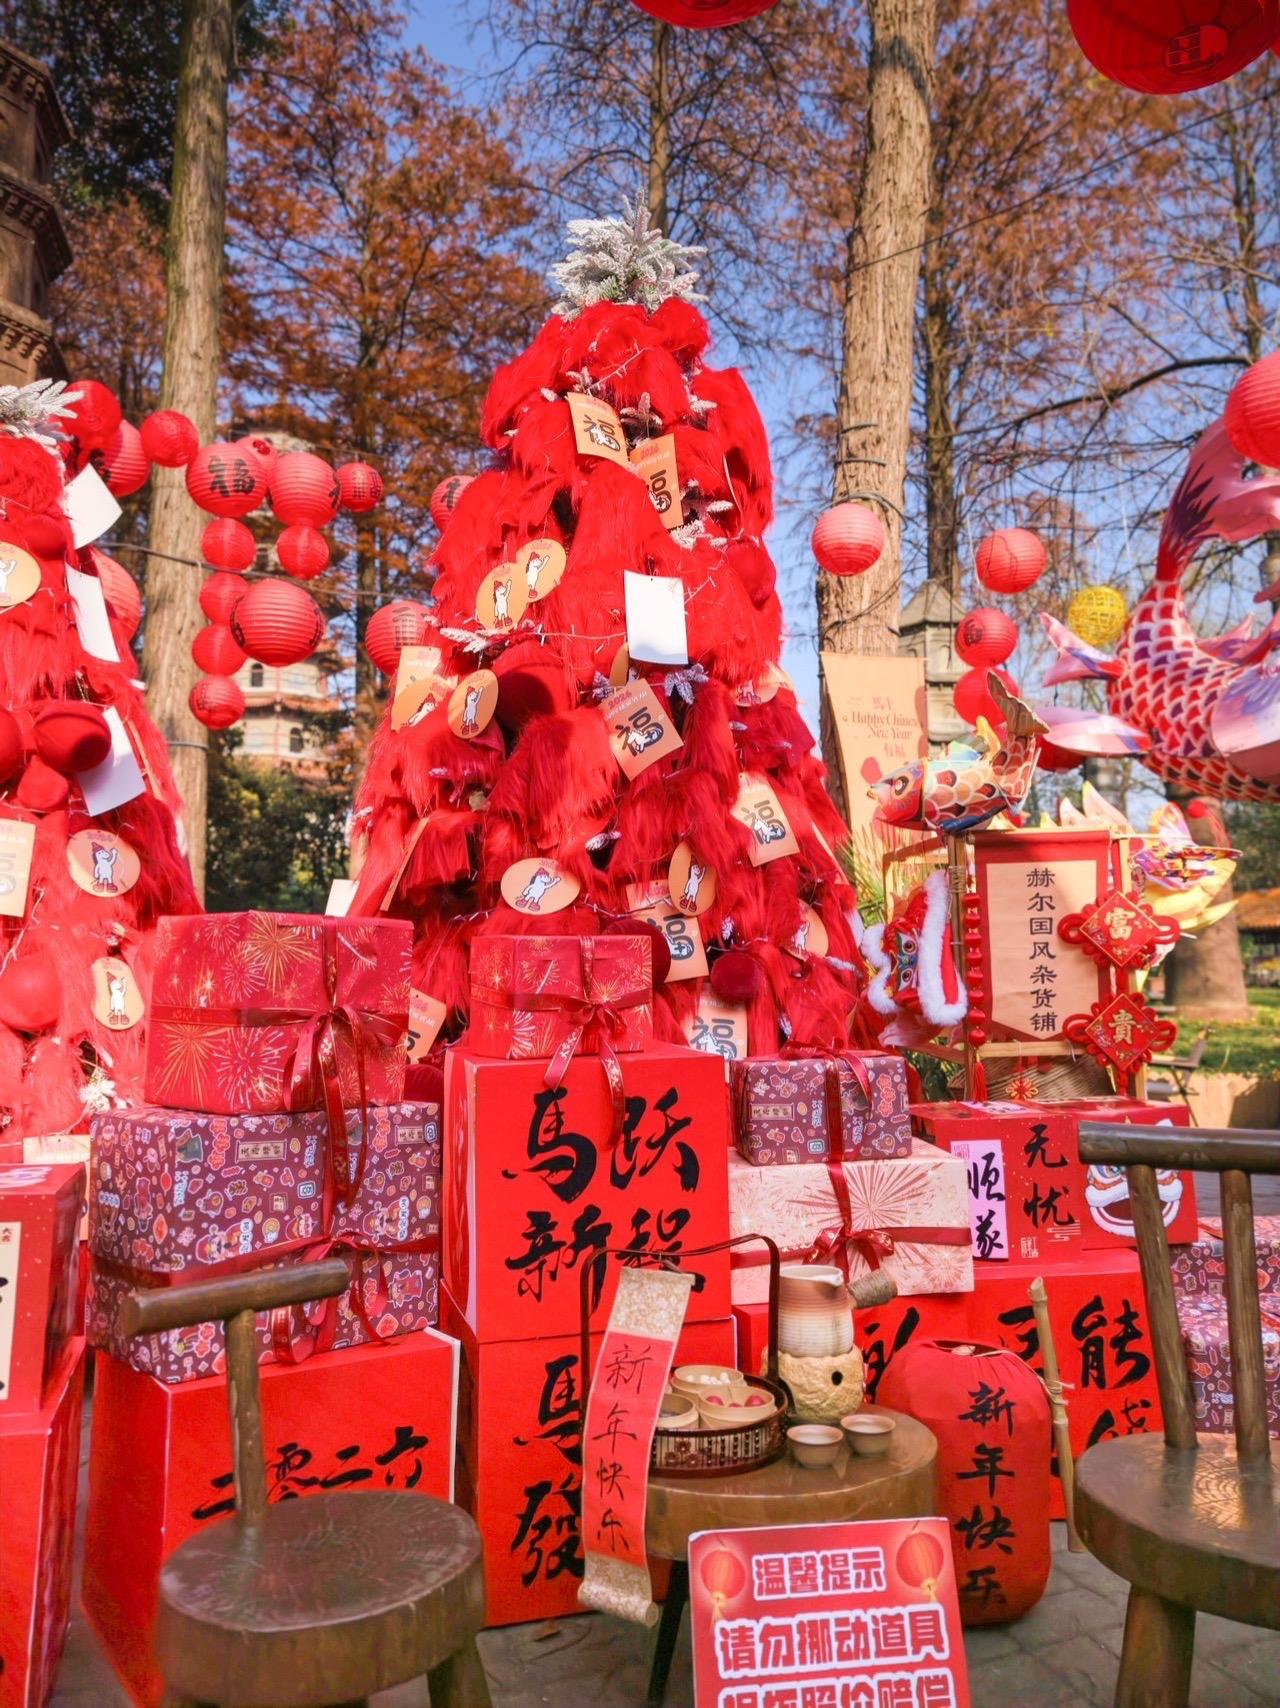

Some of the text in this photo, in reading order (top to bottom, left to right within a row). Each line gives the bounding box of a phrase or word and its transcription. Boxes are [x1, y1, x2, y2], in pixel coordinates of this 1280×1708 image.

[207, 455, 256, 498] 福
[1026, 867, 1058, 1033] 赫尔国风杂货铺
[1104, 906, 1136, 942] 富
[1023, 1123, 1076, 1229] 无忧
[591, 1343, 657, 1553] 新年快乐
[954, 1380, 1017, 1608] 新年快乐
[753, 1548, 886, 1599] 温馨提示
[717, 1606, 948, 1676] 请勿挪动道具
